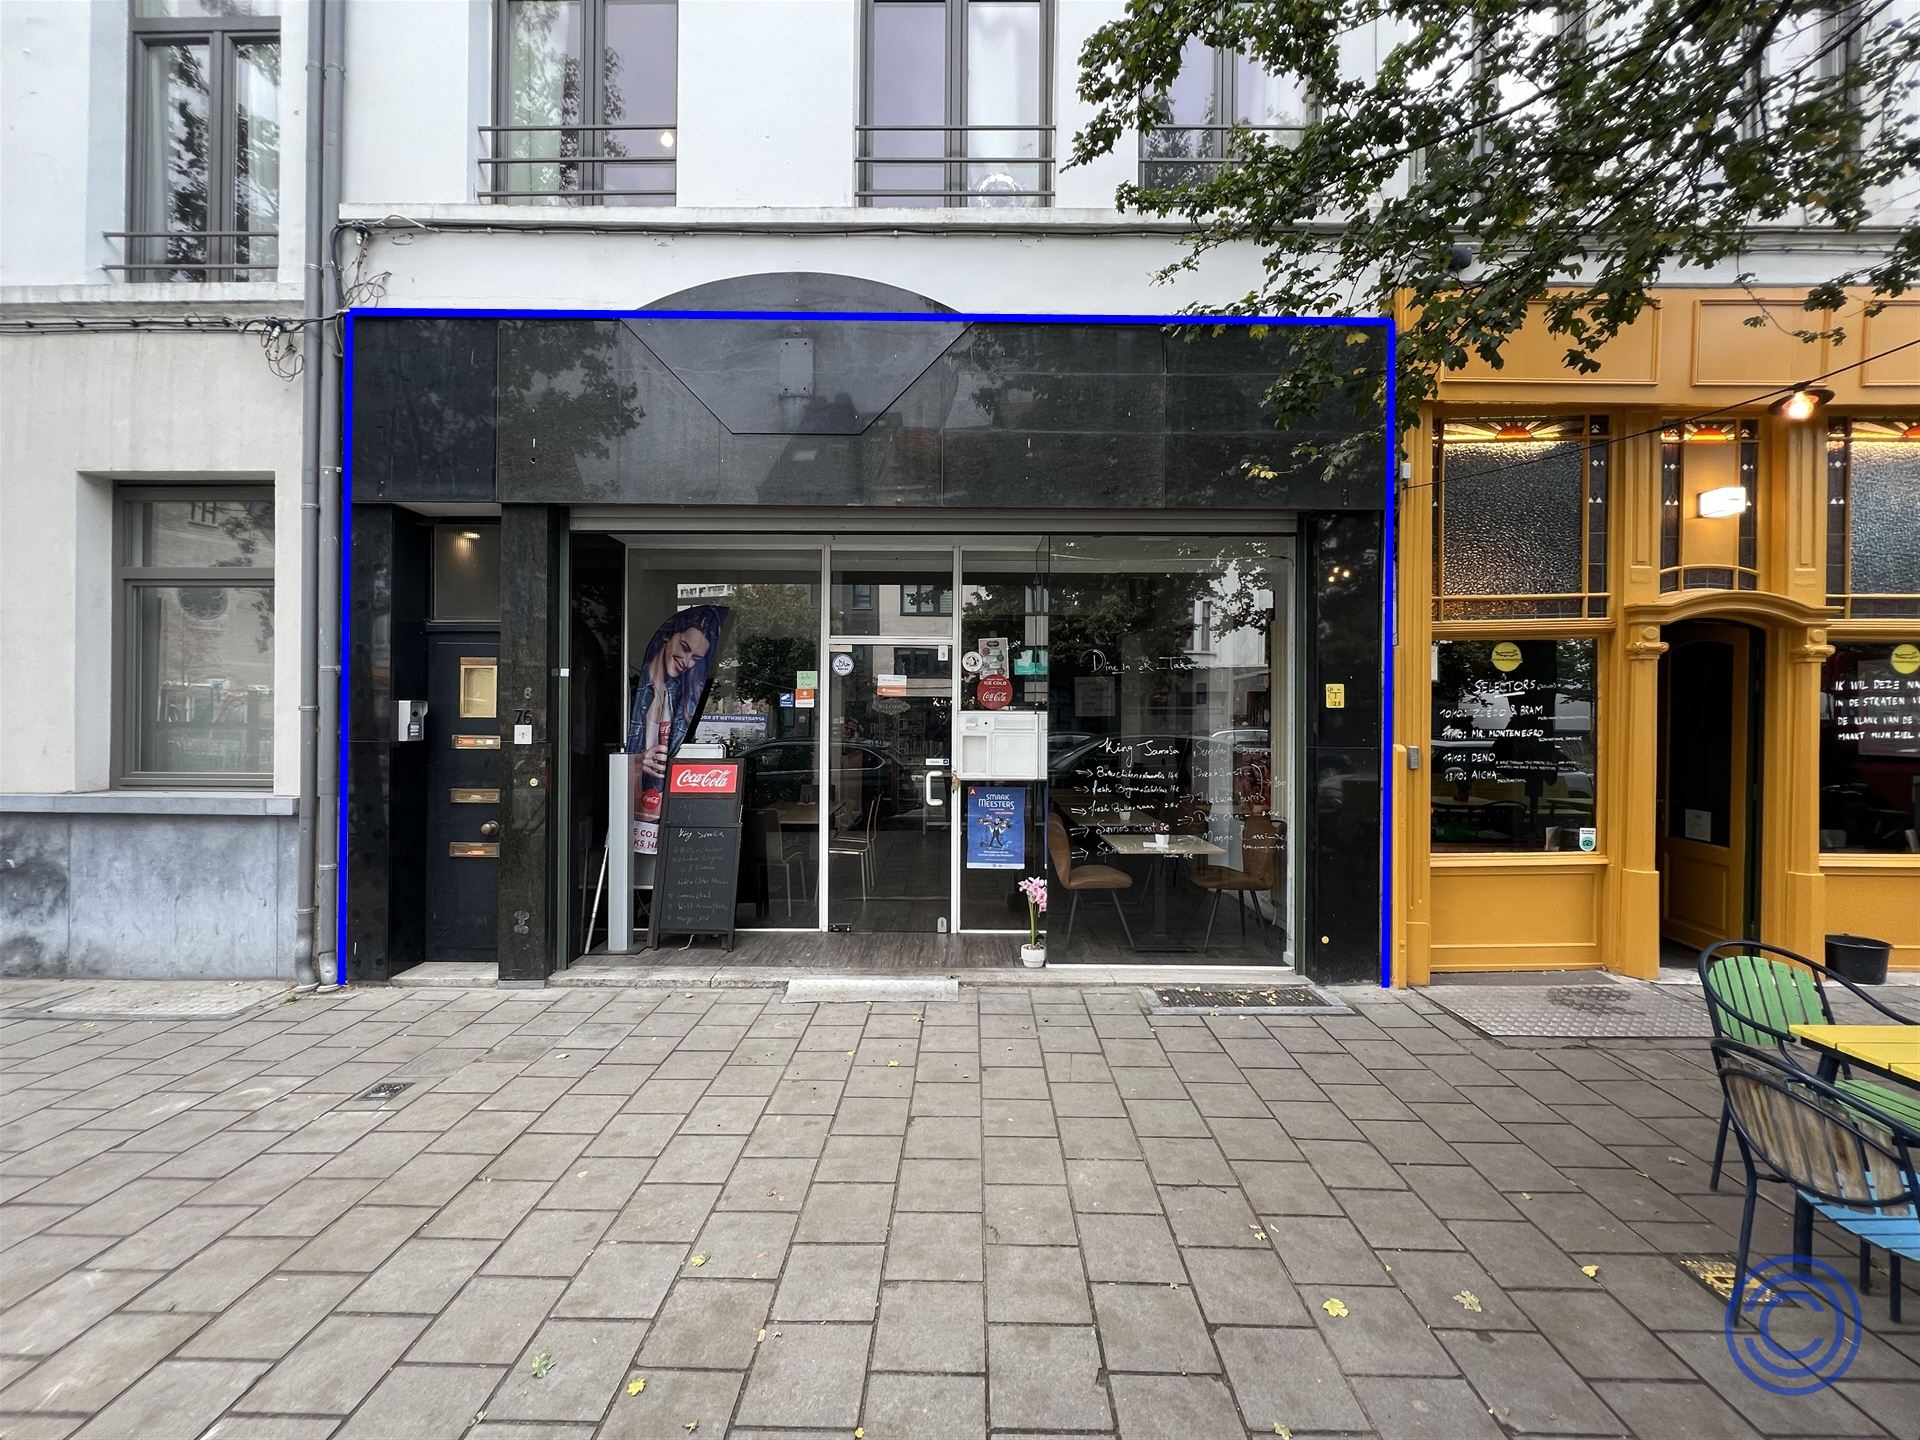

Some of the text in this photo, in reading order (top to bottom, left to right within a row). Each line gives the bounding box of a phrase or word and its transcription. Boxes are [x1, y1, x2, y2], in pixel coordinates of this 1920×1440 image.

[1473, 679, 1536, 695] SELECTORS
[1835, 681, 1845, 691] IK
[1850, 681, 1869, 690] WIL
[1873, 680, 1900, 690] DEZE
[1849, 699, 1860, 707] DE
[1863, 697, 1905, 707] STRATEN
[1520, 705, 1544, 716] BRAM
[513, 709, 533, 725] 76
[1837, 717, 1848, 725] DE
[1903, 716, 1913, 724] DE
[1488, 729, 1544, 738] MONTENEGRO
[1837, 732, 1865, 740] MAAKT
[1894, 731, 1914, 739] ZIEL
[1098, 737, 1133, 768] King
[1471, 753, 1496, 762] DENO
[676, 769, 731, 788] Coca-Cola
[1471, 770, 1497, 780] AICHA
[986, 793, 1010, 801] SMAAK
[978, 798, 1015, 810] MEESTERS
